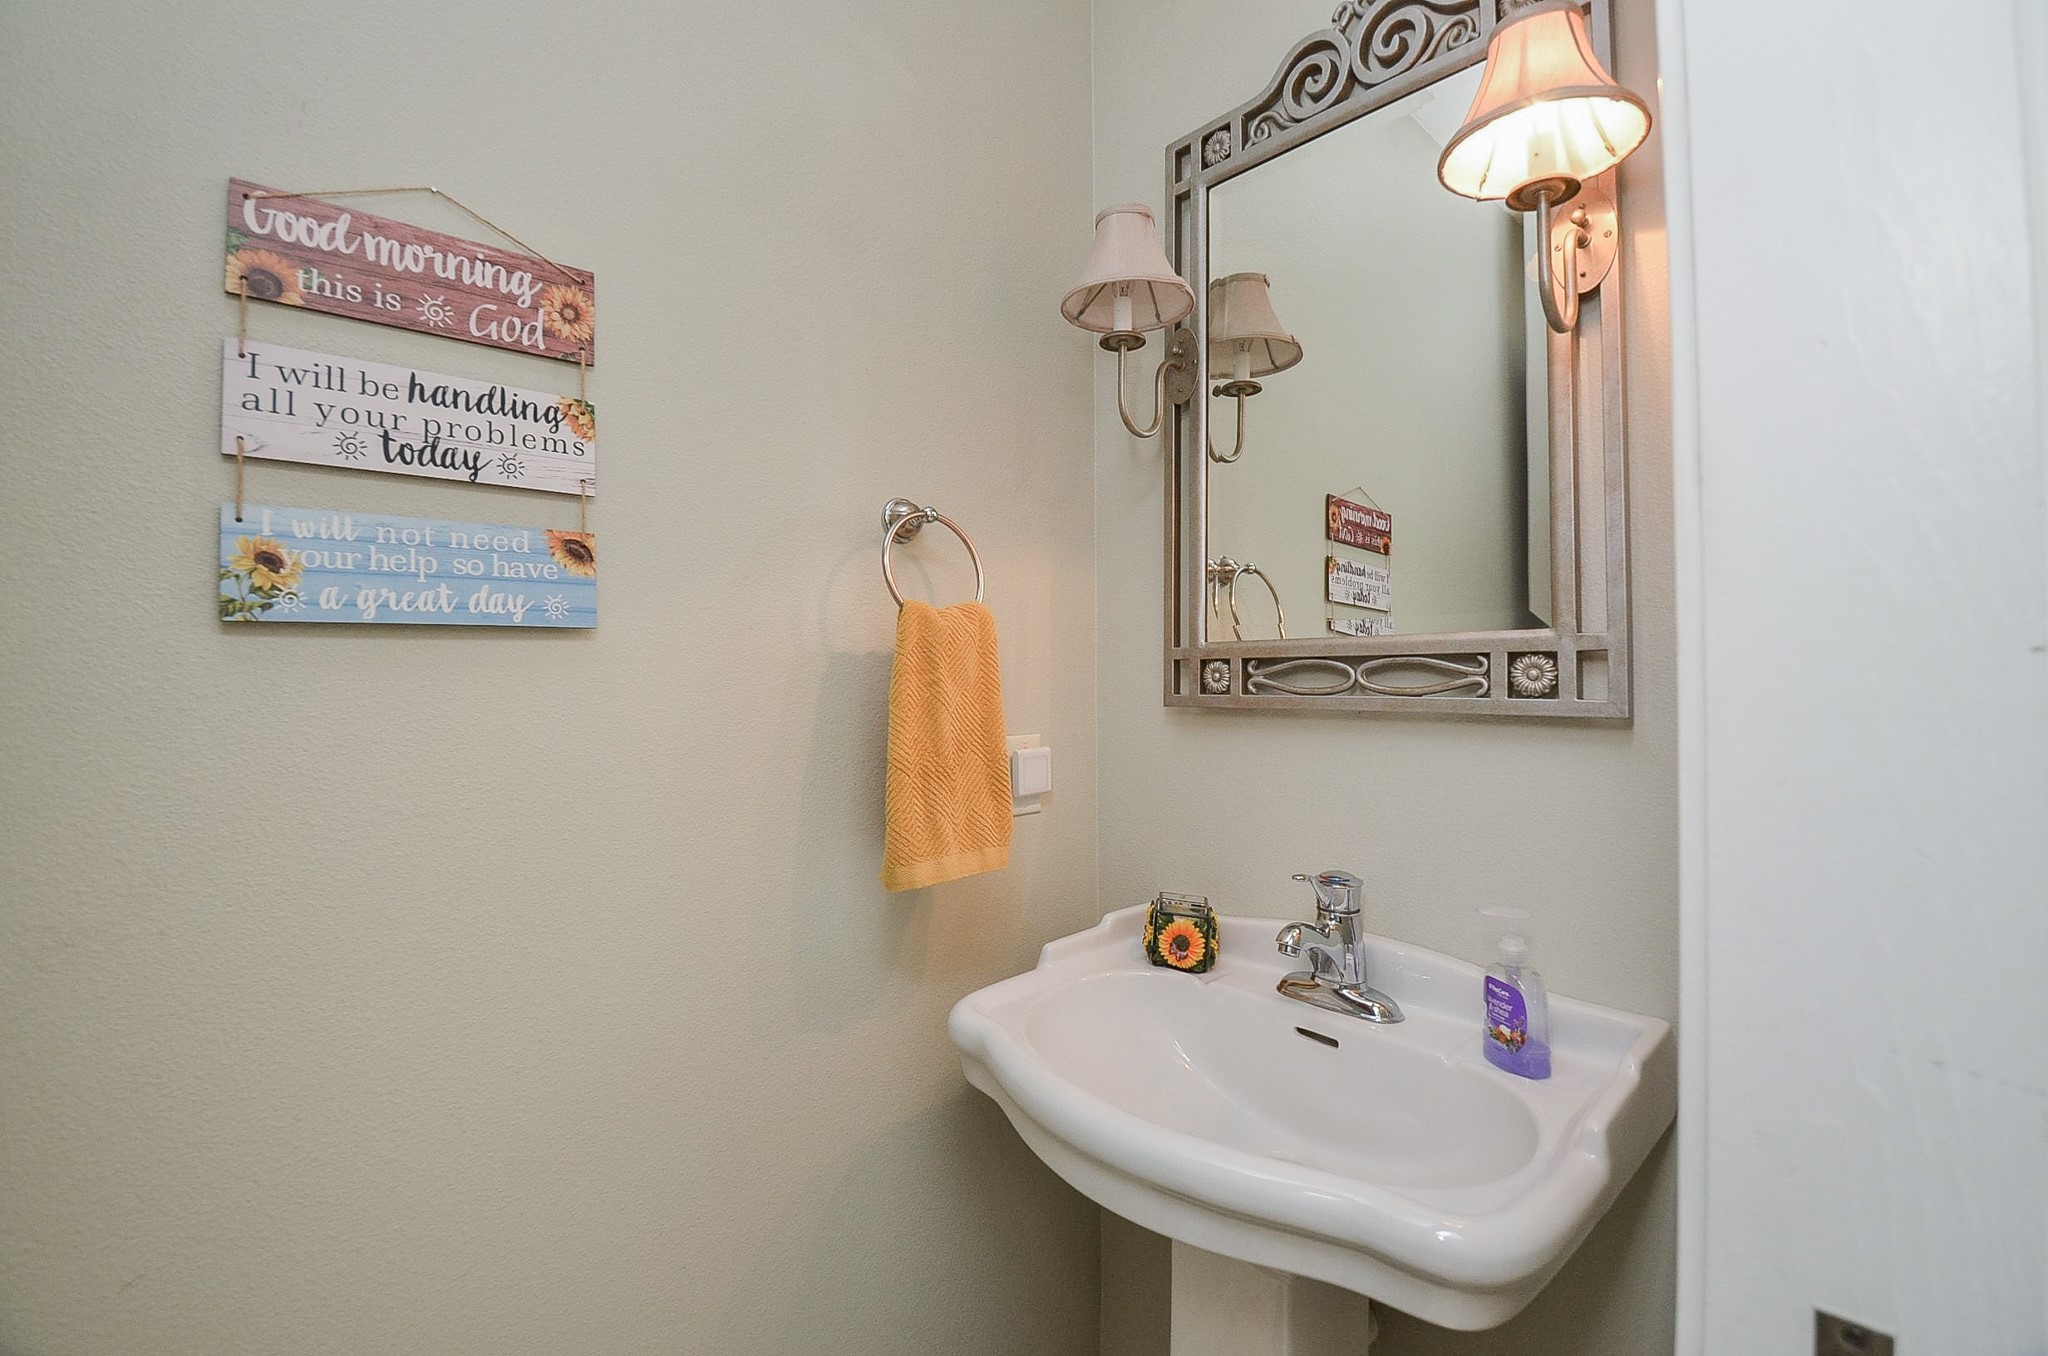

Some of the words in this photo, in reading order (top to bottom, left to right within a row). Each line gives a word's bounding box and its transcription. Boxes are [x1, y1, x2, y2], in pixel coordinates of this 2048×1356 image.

[243, 190, 361, 254] Good
[364, 231, 543, 307] morning
[296, 268, 362, 303] this
[374, 282, 401, 312] is
[469, 304, 546, 350] God
[242, 387, 296, 417] all
[314, 399, 407, 431] your
[422, 417, 585, 458] problems
[247, 352, 261, 380] I
[275, 362, 347, 393] will
[359, 370, 399, 401] be
[408, 371, 566, 434] handling
[378, 429, 493, 482] today
[261, 509, 273, 536] I
[292, 515, 361, 542] will
[375, 524, 435, 548] not
[449, 530, 531, 554] need
[279, 546, 362, 574] your
[368, 545, 437, 582] help
[453, 555, 484, 576] so
[491, 553, 558, 580] have
[320, 583, 346, 610] a
[357, 583, 458, 620] great
[469, 585, 534, 623] day
